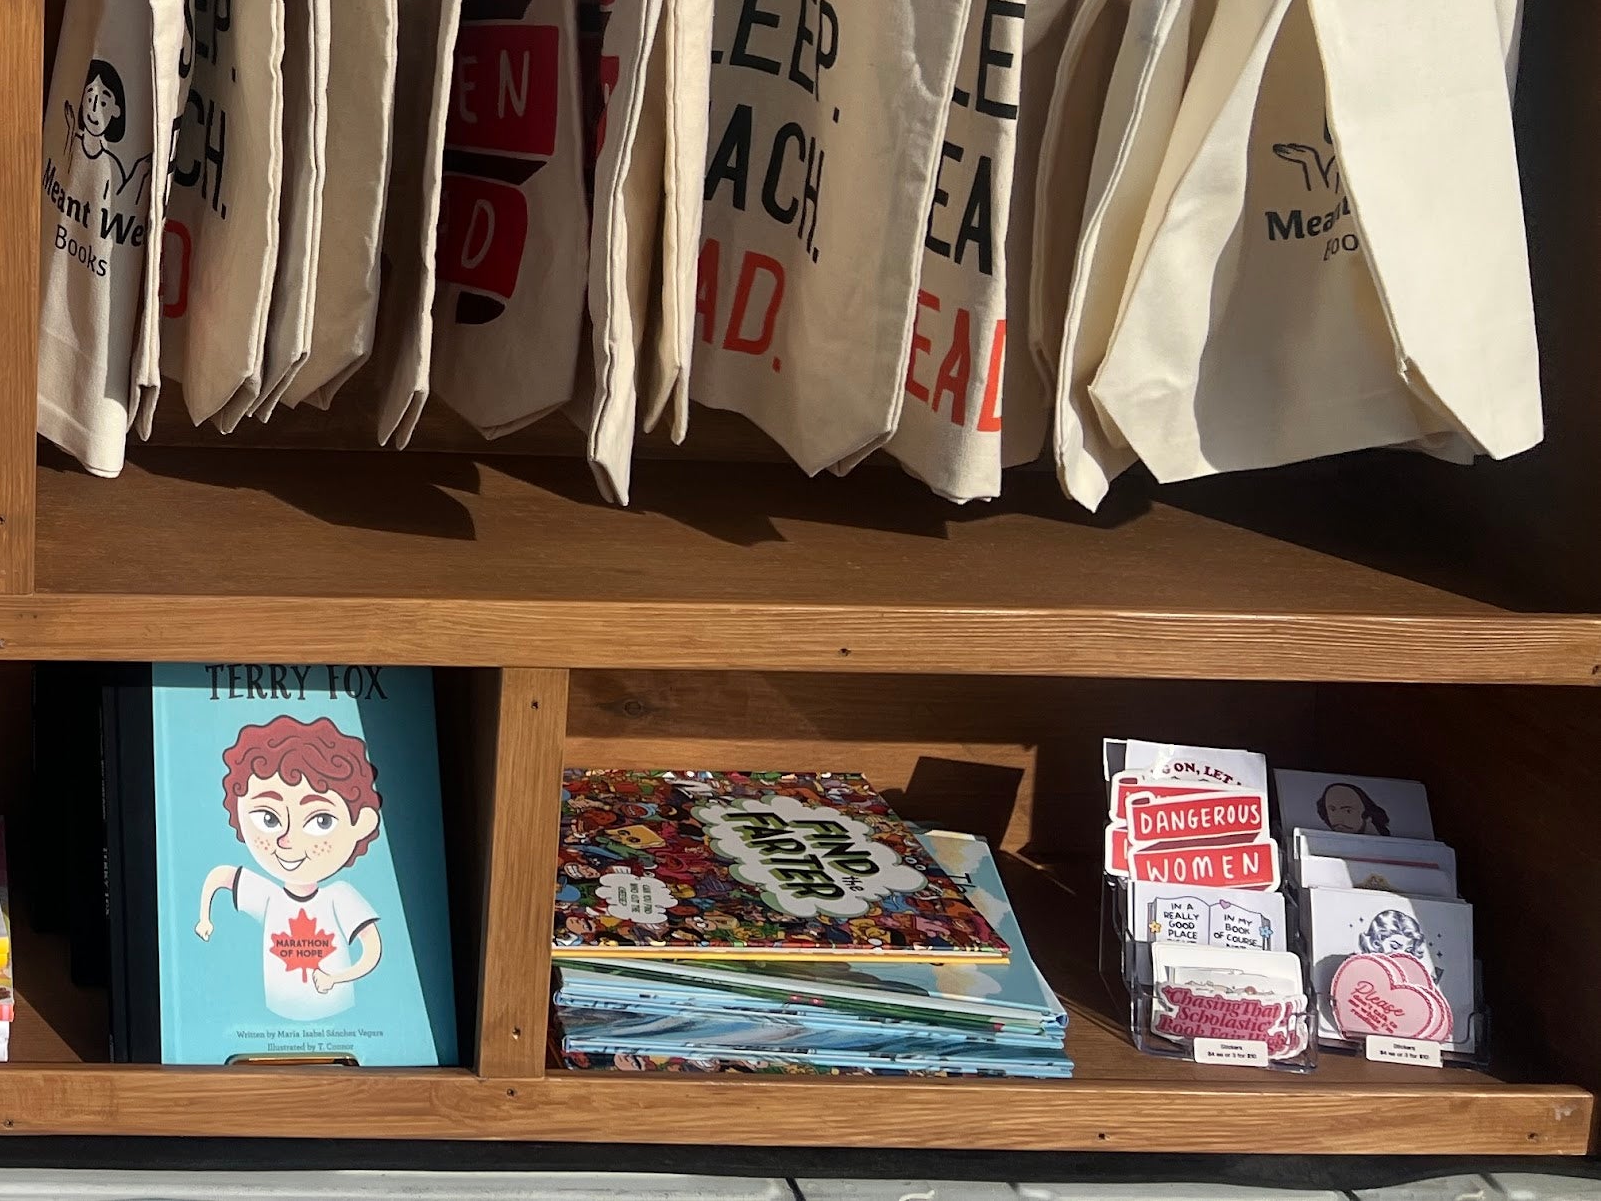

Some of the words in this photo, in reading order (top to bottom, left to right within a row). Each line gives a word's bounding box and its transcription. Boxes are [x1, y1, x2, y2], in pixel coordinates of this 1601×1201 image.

[42, 158, 90, 229] Meant
[55, 224, 107, 277] Books
[205, 664, 310, 701] TERRY
[328, 666, 388, 701] FOX
[1140, 804, 1260, 834] DANGEROUS
[1147, 852, 1259, 882] WOMEN
[276, 939, 329, 948] MARATHON
[1168, 929, 1197, 939] PLACE
[296, 949, 323, 958] HOPE
